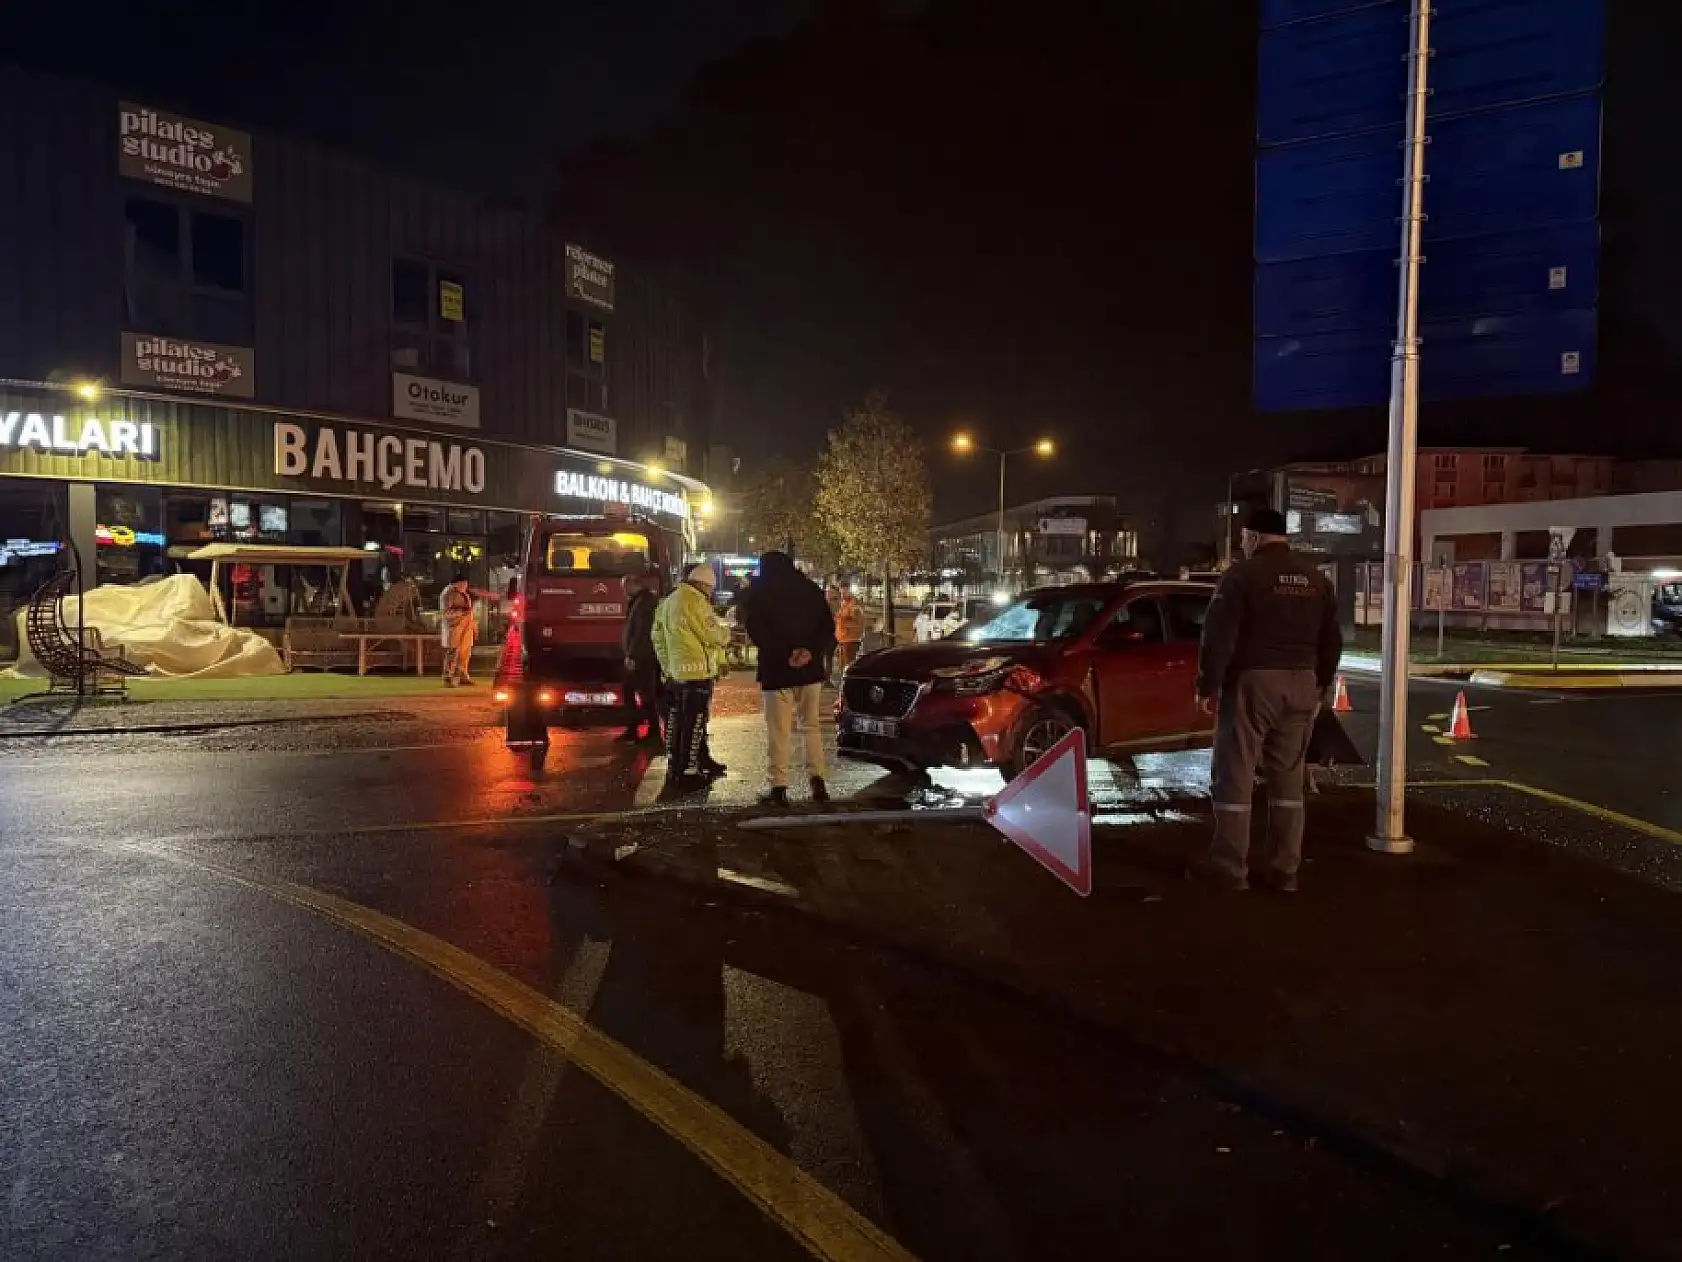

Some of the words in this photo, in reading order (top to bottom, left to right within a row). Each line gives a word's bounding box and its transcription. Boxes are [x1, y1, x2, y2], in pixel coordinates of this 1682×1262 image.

[120, 108, 214, 149] pilates
[122, 136, 213, 171] studio
[136, 336, 216, 361] pilates
[137, 357, 214, 377] studio
[274, 422, 485, 494] BAHÇEMO
[554, 469, 618, 502] BALKON
[619, 480, 630, 504] &
